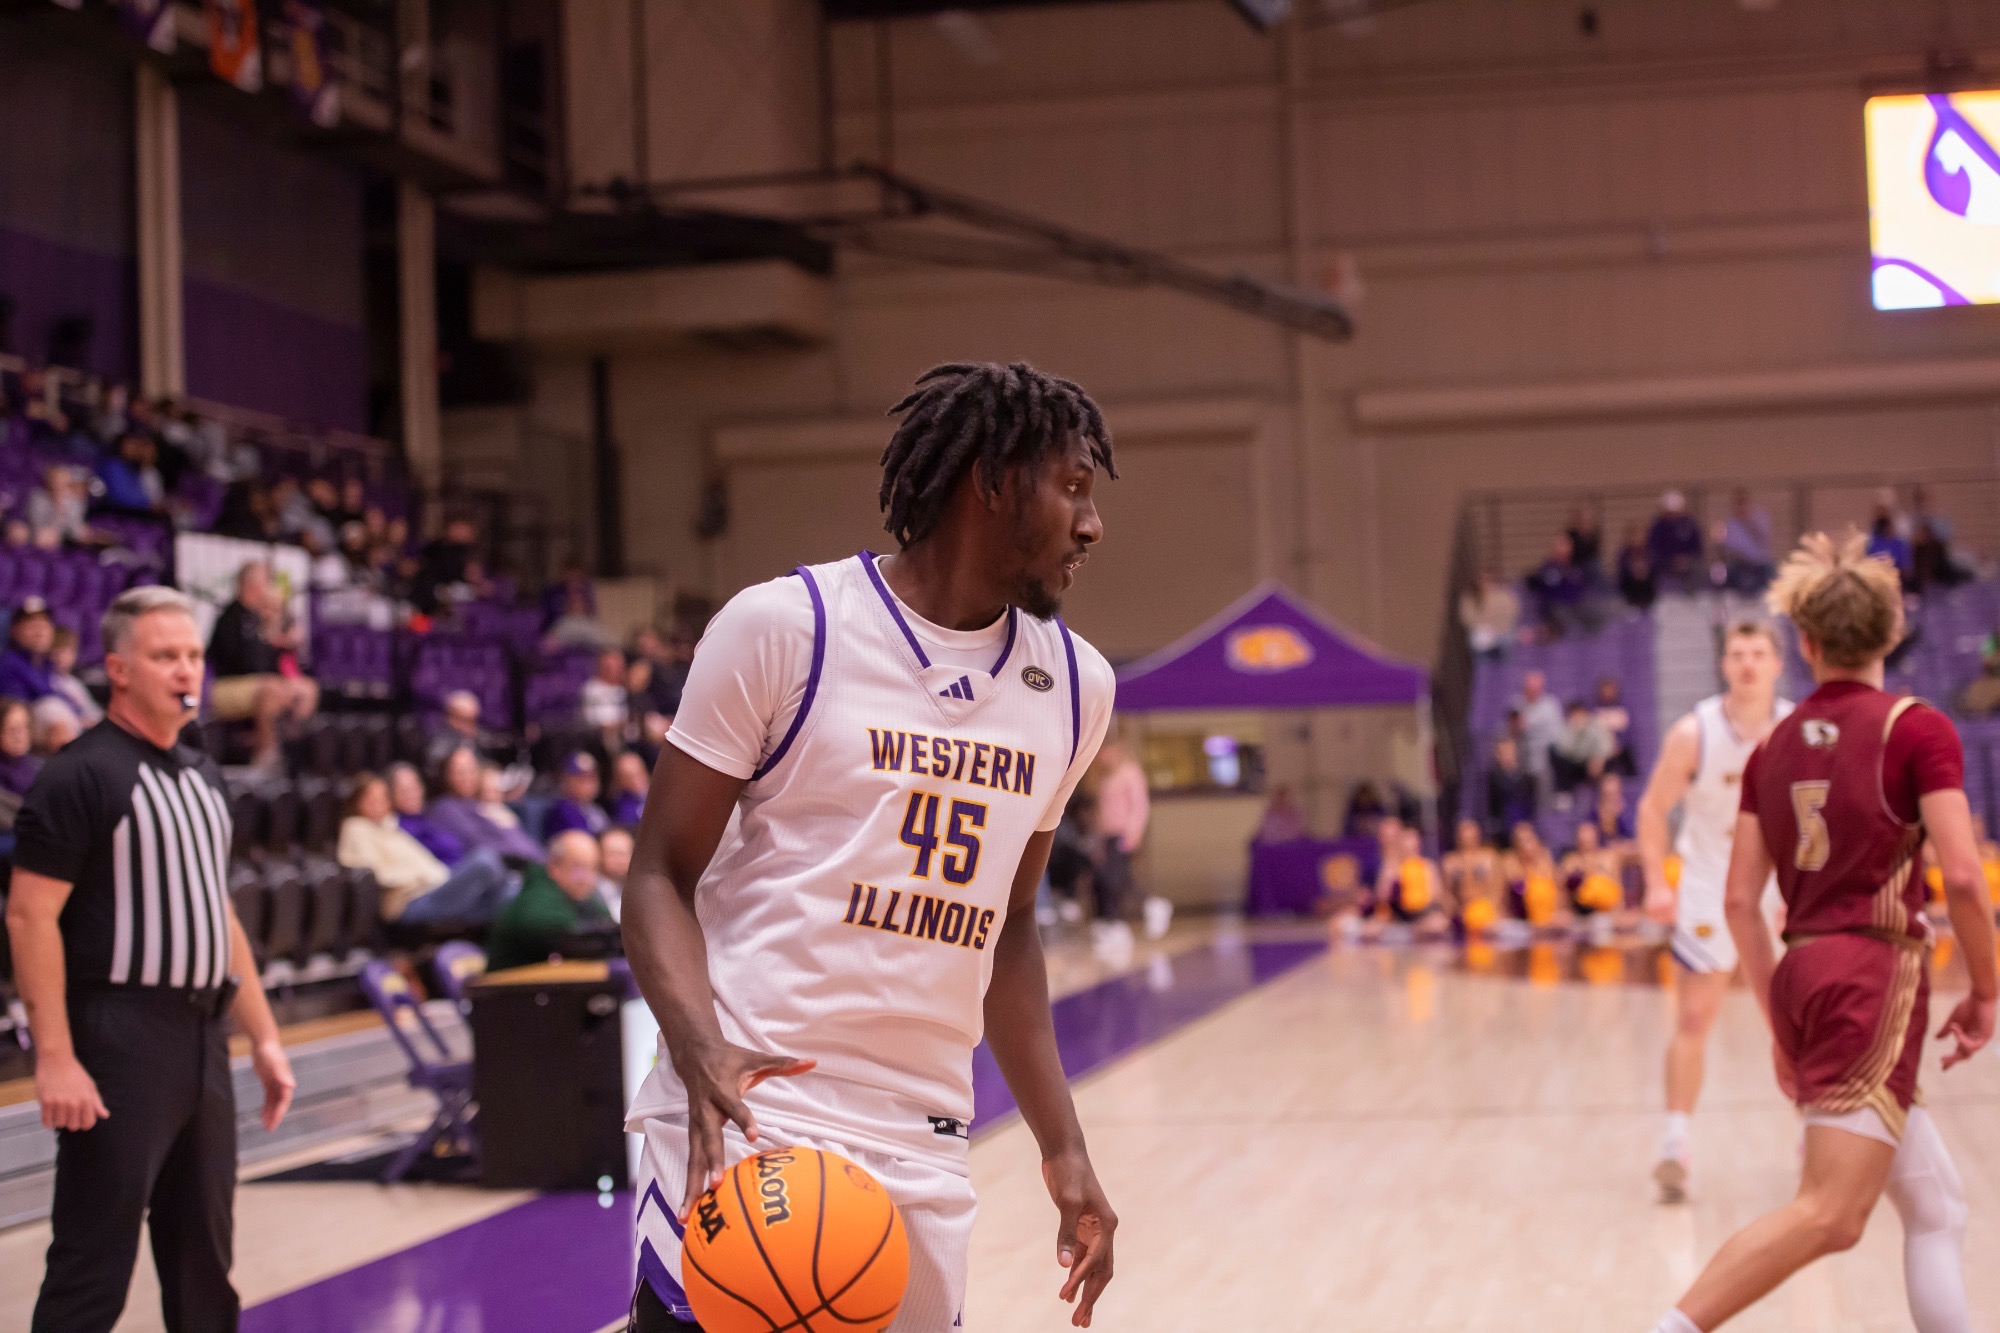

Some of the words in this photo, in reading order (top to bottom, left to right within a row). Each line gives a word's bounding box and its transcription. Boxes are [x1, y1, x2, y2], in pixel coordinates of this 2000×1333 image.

[866, 727, 1037, 797] WESTERN
[897, 788, 989, 888] 45
[1790, 779, 1831, 872] 5
[841, 881, 996, 951] ILLINOIS
